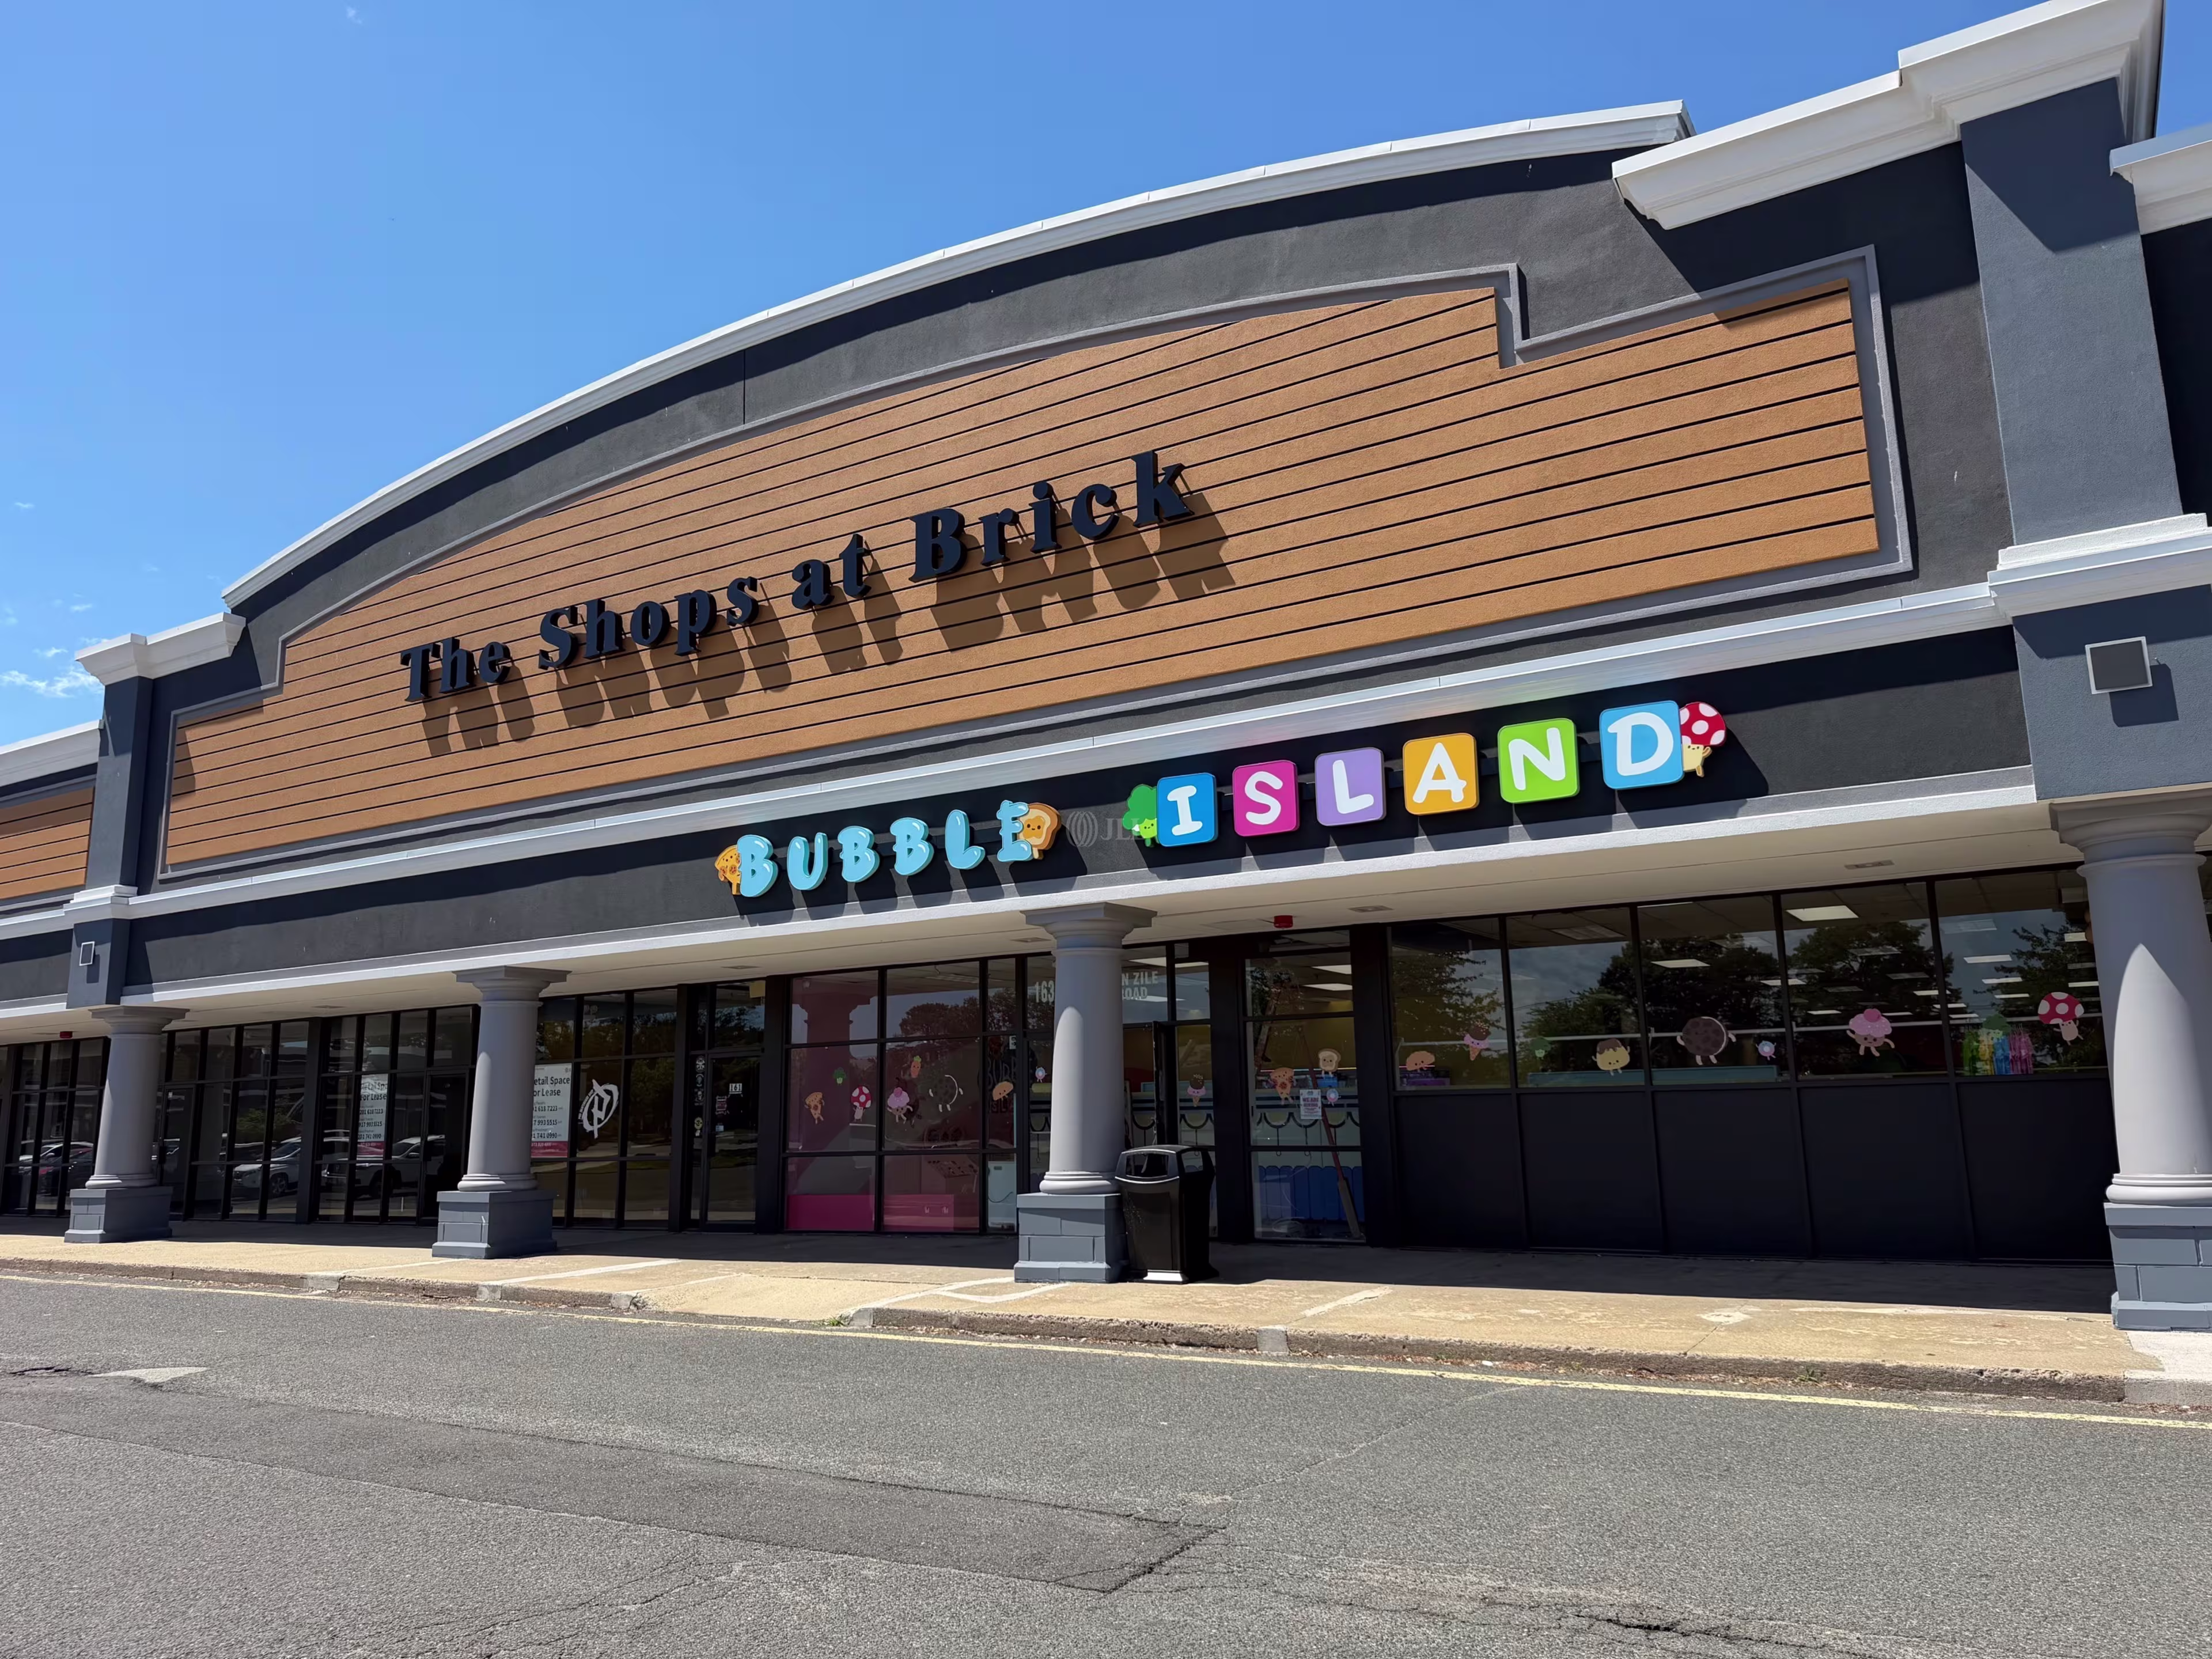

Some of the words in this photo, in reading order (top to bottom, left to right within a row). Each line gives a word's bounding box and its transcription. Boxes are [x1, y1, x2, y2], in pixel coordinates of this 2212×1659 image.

[400, 637, 513, 702] The
[539, 577, 759, 669] Shops
[791, 533, 872, 611] at
[908, 449, 1195, 583] Brick
[736, 799, 1033, 898] BUBBLE
[1168, 711, 1674, 836] ISLAND
[1133, 971, 1158, 985] ZILE
[1035, 980, 1055, 1003] 163
[1122, 986, 1148, 1001] OAD
[533, 1076, 548, 1085] etail
[550, 1076, 570, 1087] Space
[542, 1088, 561, 1096] Lease
